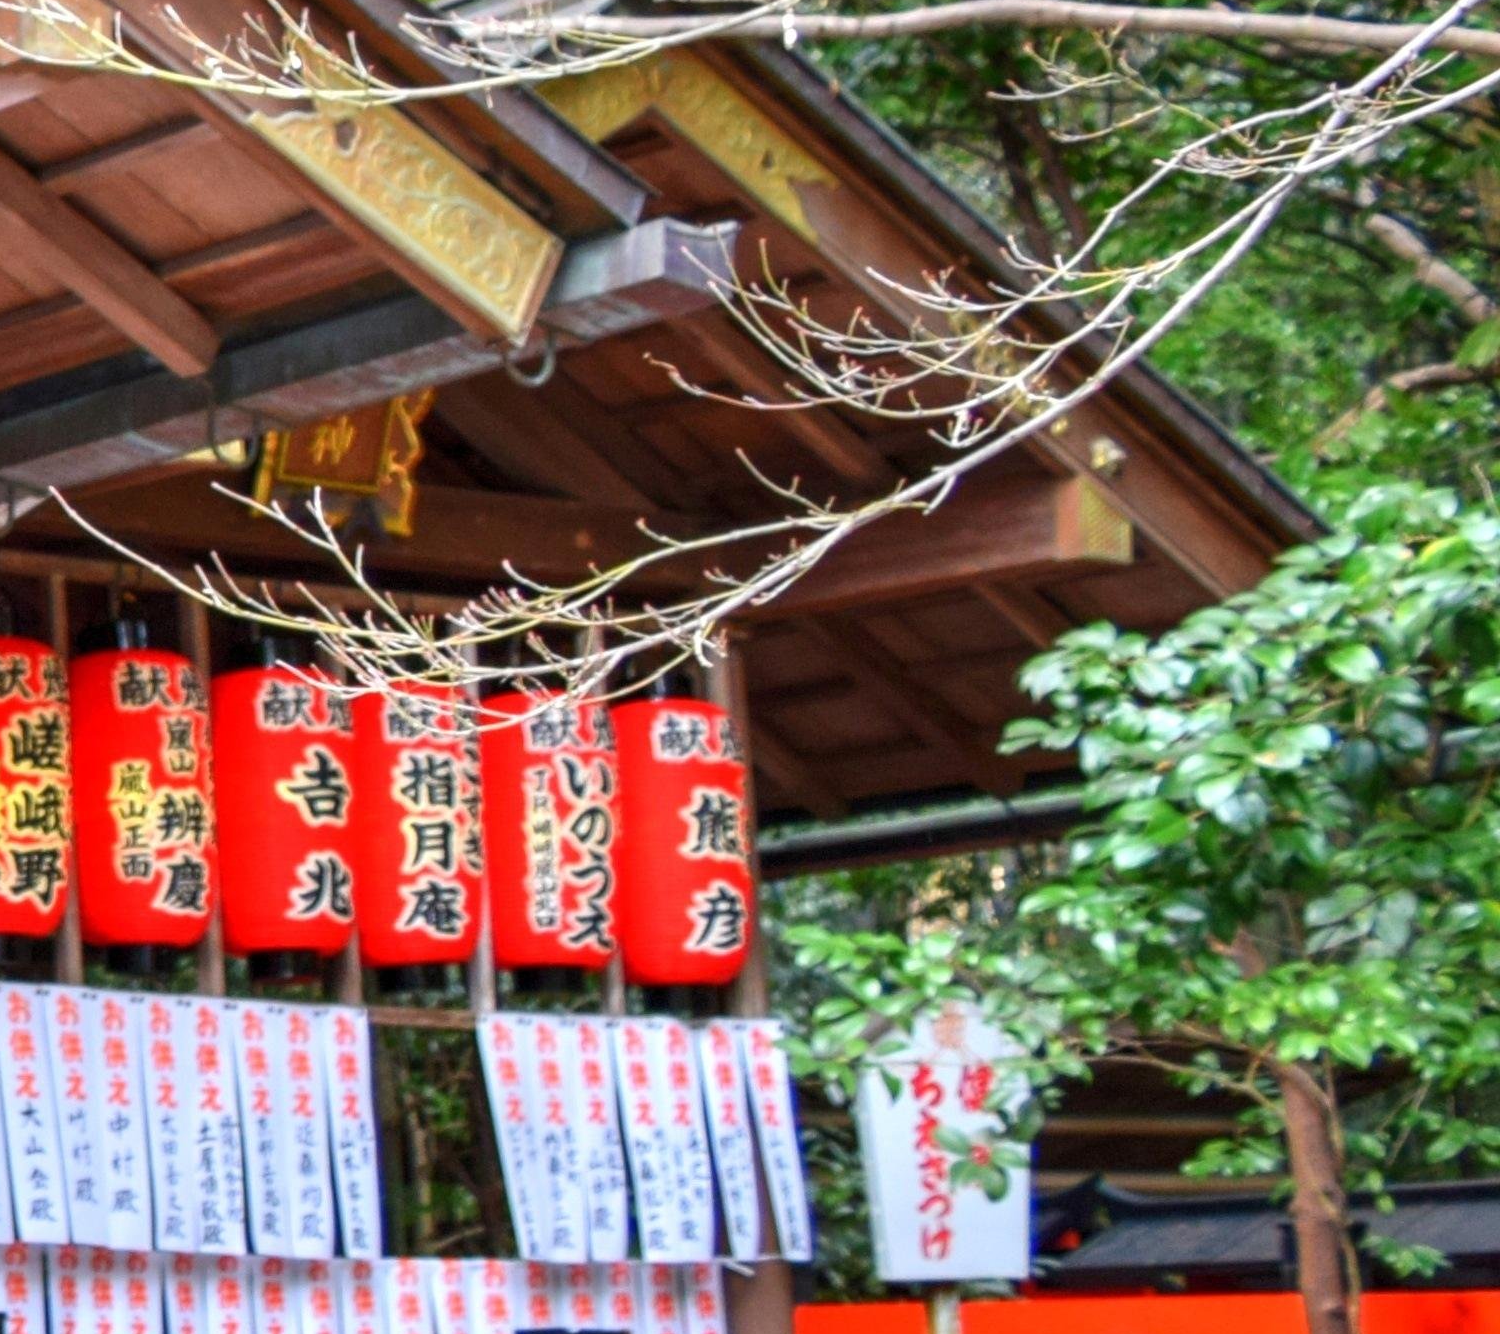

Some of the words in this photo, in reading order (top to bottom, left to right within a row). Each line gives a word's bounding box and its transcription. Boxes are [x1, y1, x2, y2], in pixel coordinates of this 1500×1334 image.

[8, 713, 70, 906] 嵯峨野
[288, 749, 352, 918] 吉兆
[401, 755, 464, 935] 指月庵
[561, 756, 614, 950] いのうえ
[690, 792, 745, 950] 熊彦
[527, 1261, 552, 1325] お供
[569, 1264, 595, 1323] お供
[610, 1262, 634, 1321] お供
